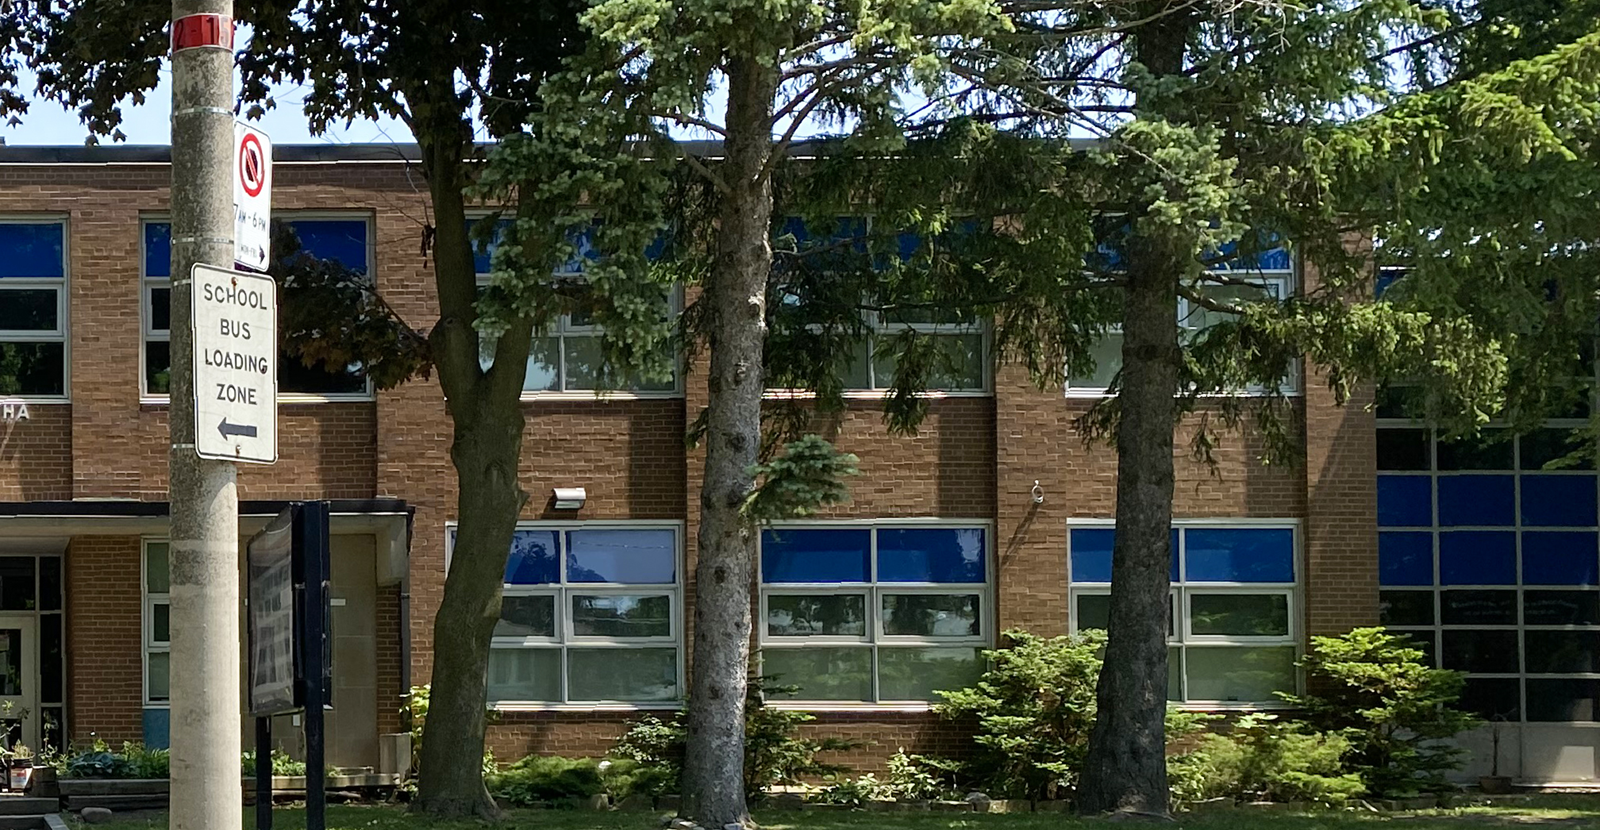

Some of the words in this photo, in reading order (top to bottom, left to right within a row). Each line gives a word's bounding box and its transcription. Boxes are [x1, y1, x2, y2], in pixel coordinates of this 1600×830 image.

[204, 283, 267, 310] SCHOOL
[220, 318, 251, 340] BUS
[205, 348, 268, 374] LOADING
[216, 383, 257, 405] ZONE
